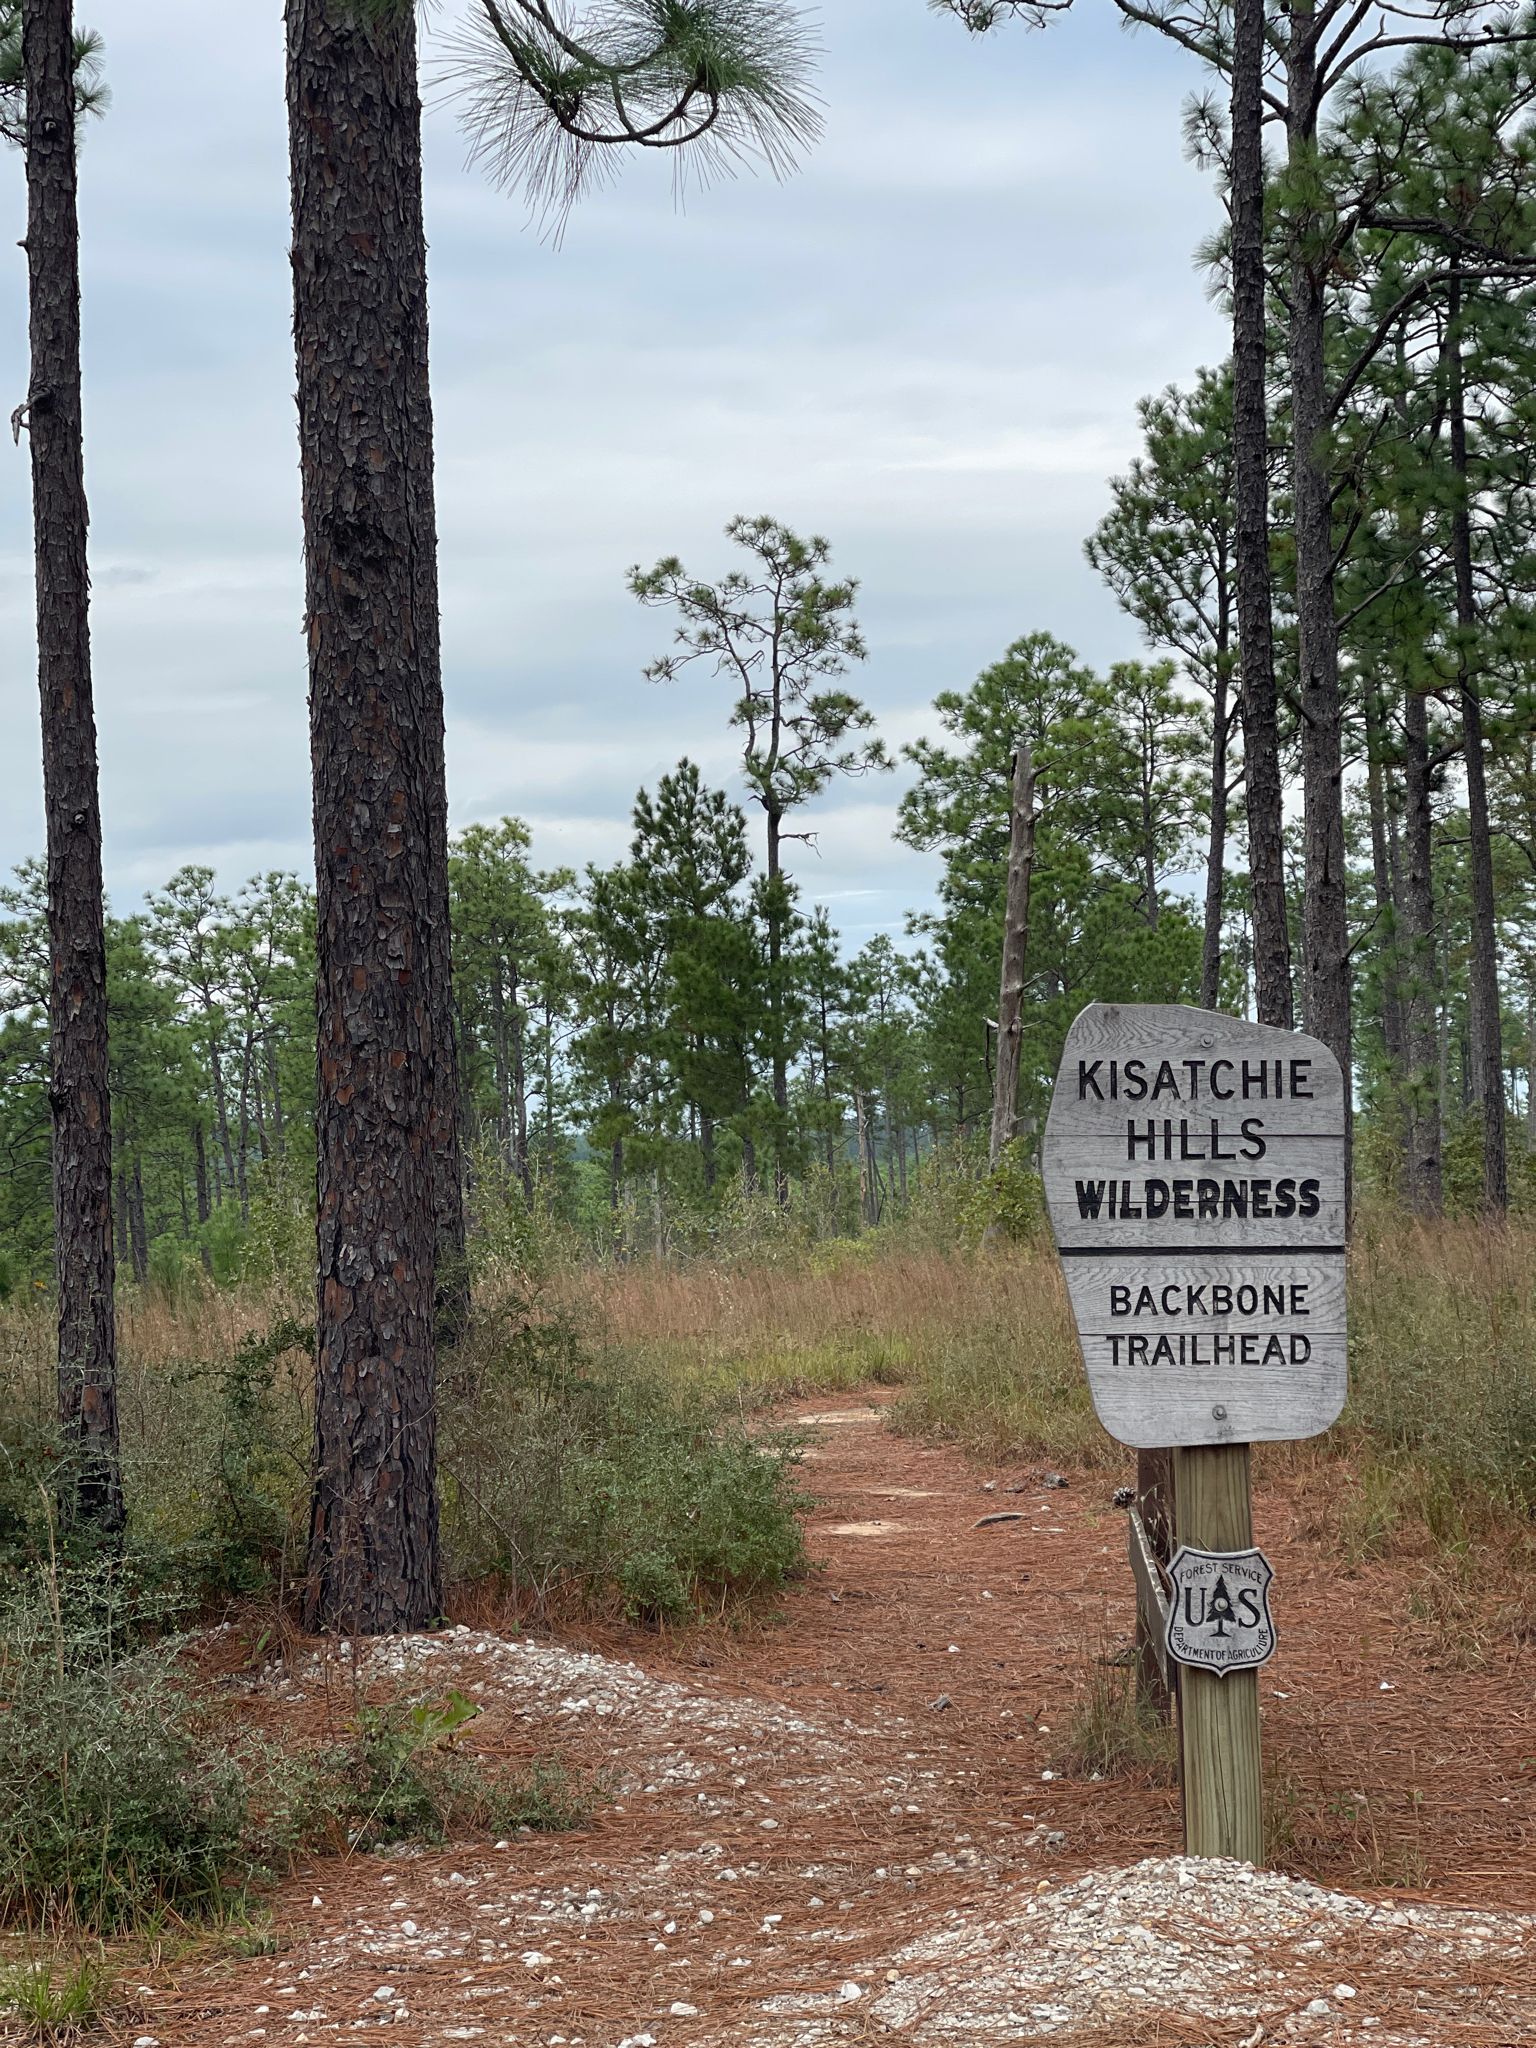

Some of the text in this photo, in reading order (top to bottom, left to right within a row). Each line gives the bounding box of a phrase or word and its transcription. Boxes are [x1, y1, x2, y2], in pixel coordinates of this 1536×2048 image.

[1078, 1059, 1315, 1101] KISATCHIE
[1127, 1118, 1267, 1161] HILLS
[1074, 1178, 1321, 1220] WILDERNESS
[1110, 1284, 1311, 1316] BACKBONE
[1106, 1334, 1312, 1366] TRAILHEAD
[1180, 1562, 1263, 1584] FOREST SERVICE
[1173, 1626, 1269, 1661] DEPARTMENT OF AGRICULTURE
